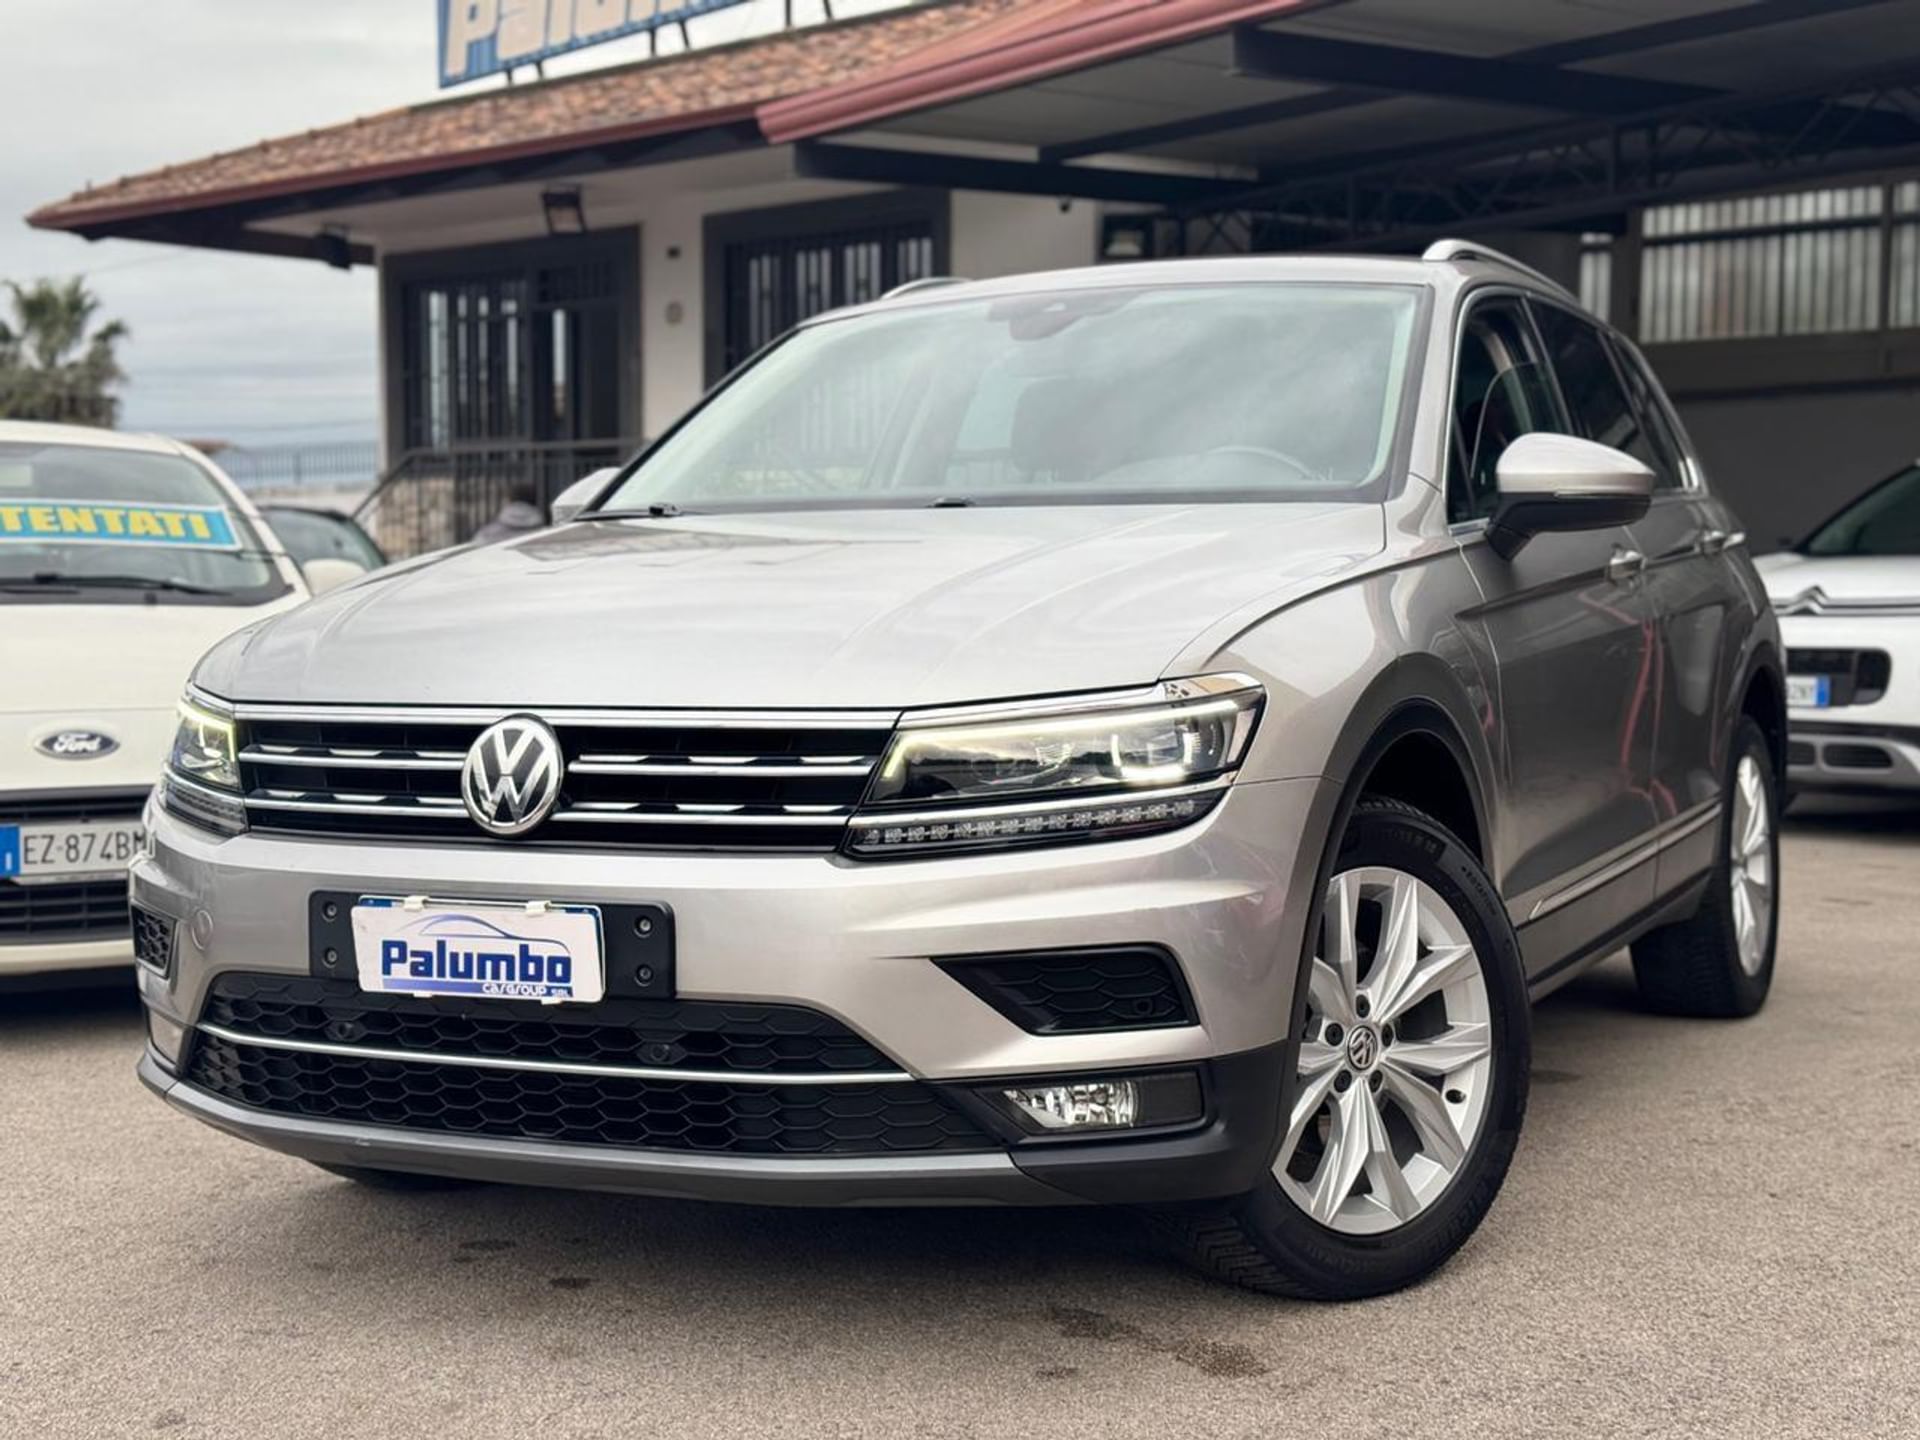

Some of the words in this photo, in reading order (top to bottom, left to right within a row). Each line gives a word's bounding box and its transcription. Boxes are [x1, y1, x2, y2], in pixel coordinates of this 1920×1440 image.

[0, 506, 212, 539] TENTATI
[53, 732, 101, 752] Ford
[381, 939, 572, 983] Palumbo
